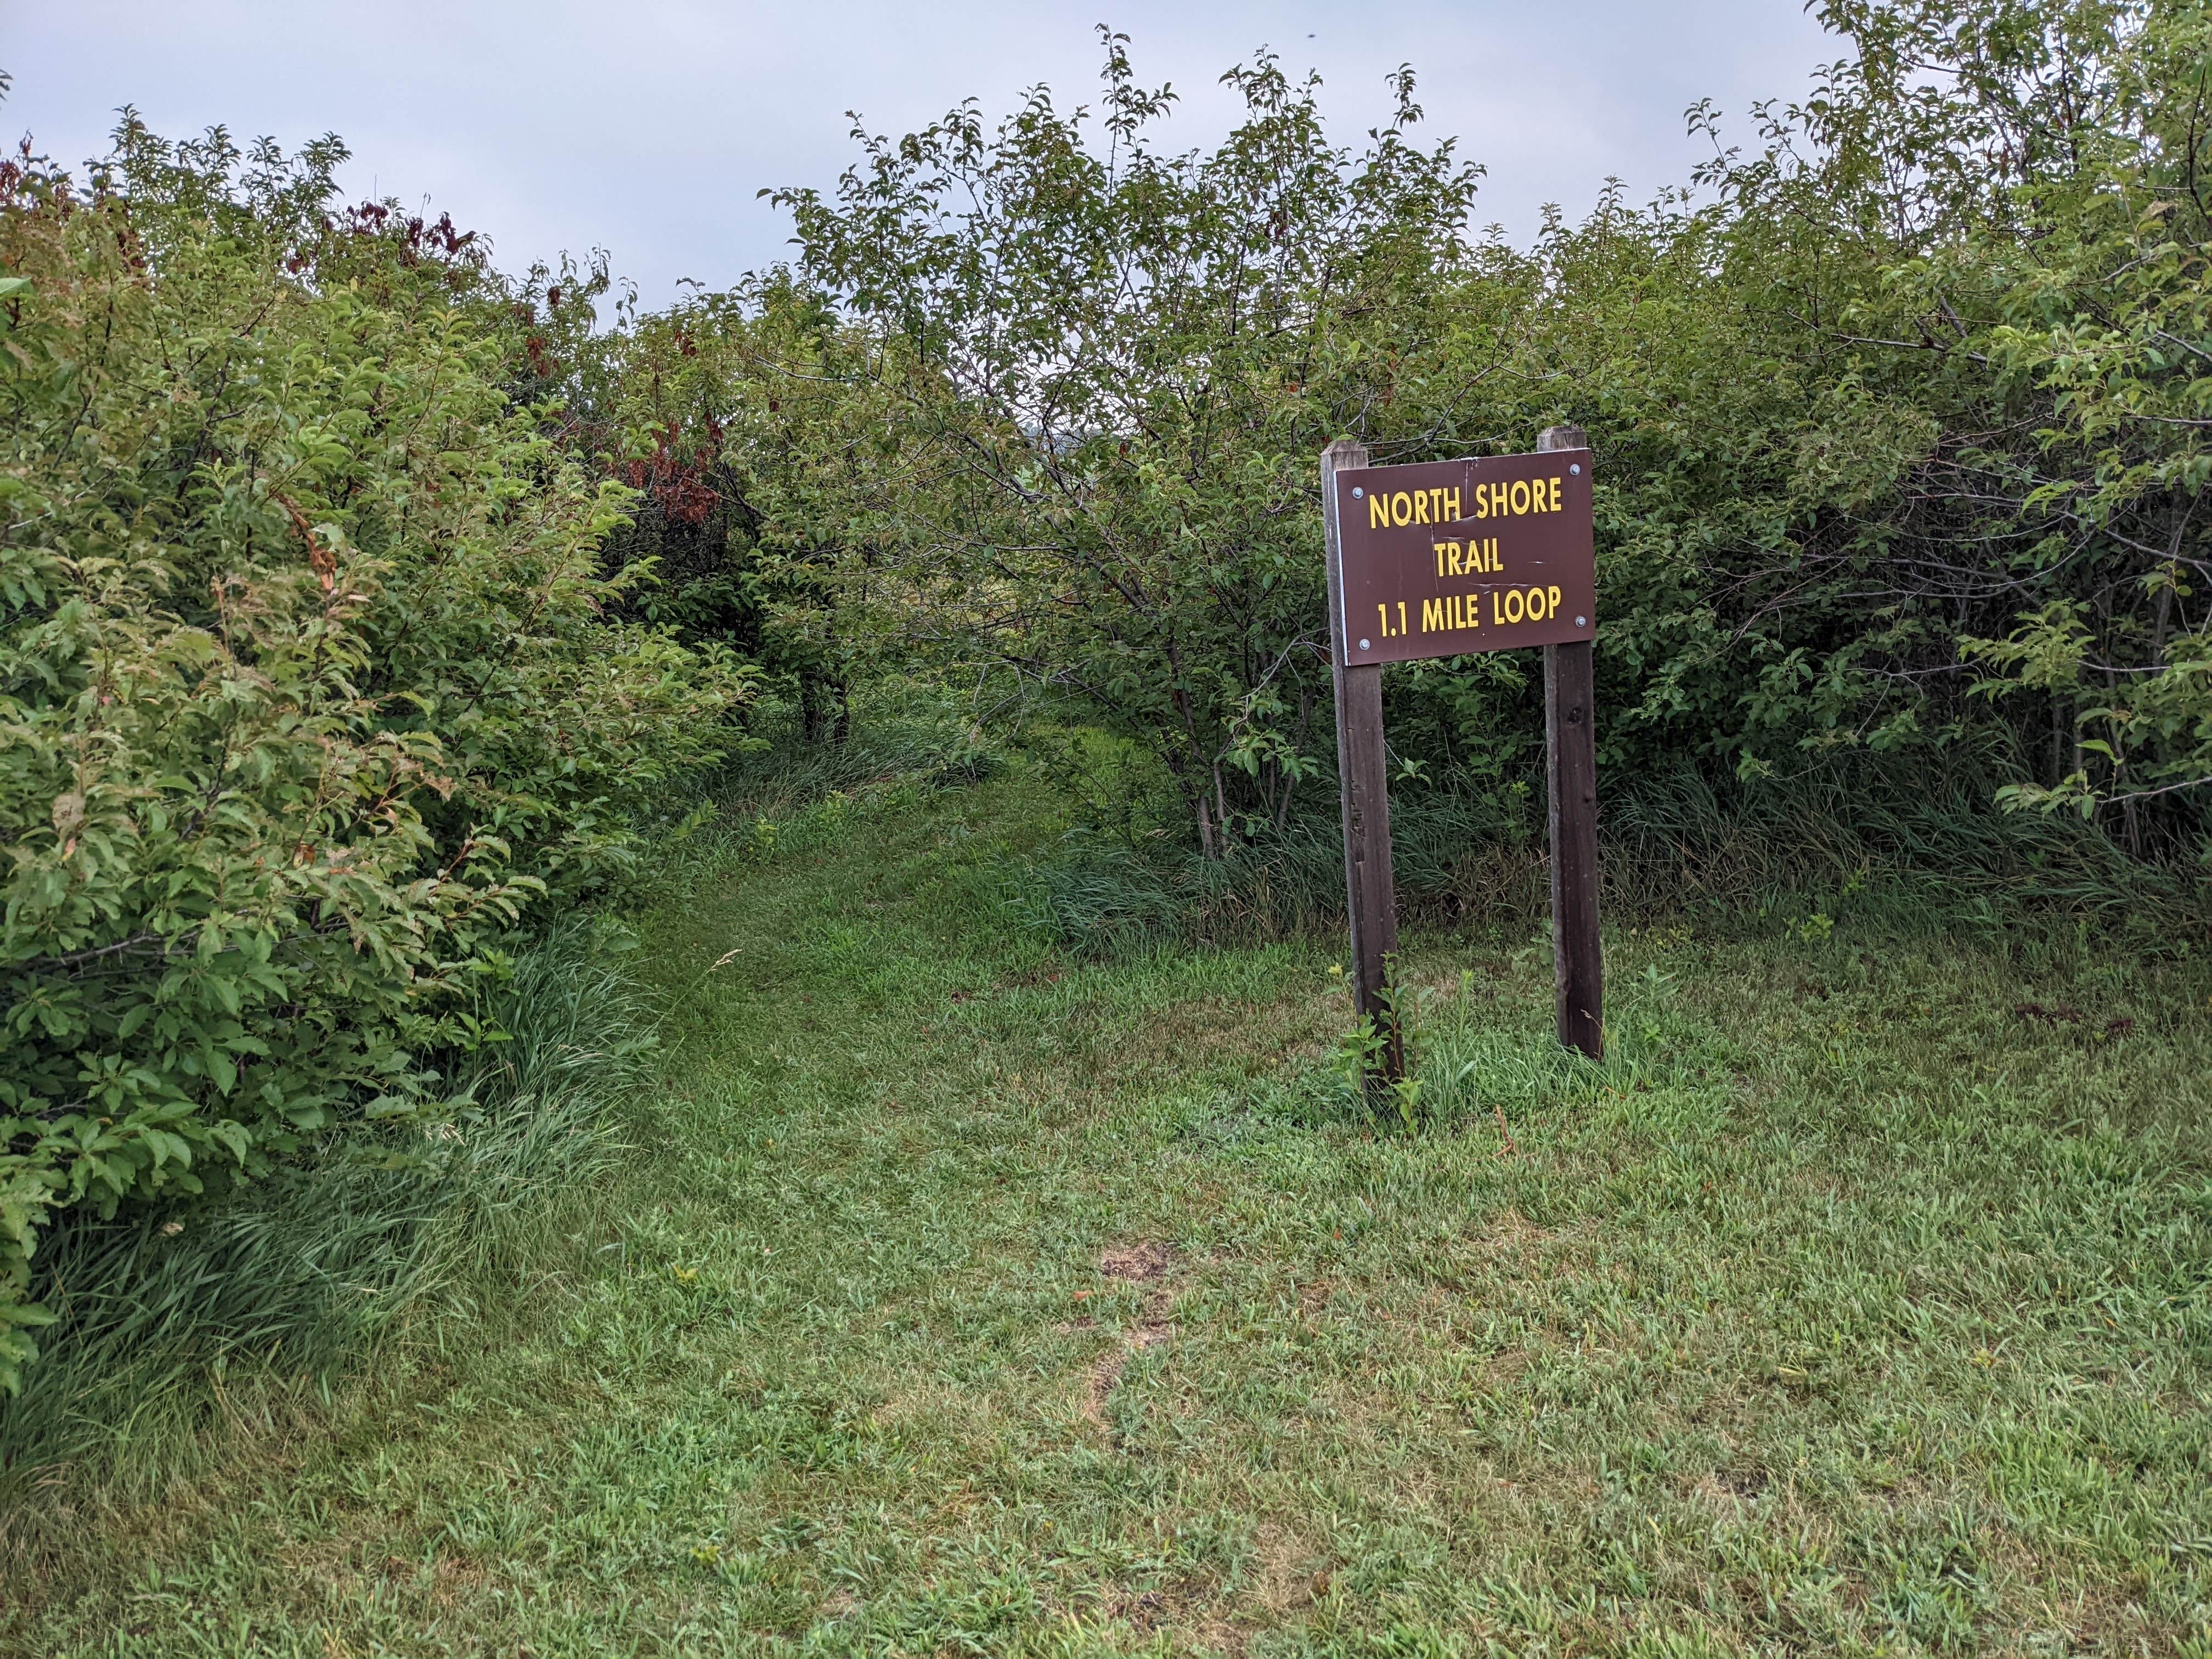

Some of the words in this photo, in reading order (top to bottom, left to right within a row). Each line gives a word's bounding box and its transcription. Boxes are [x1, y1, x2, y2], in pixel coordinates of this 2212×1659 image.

[1369, 486, 1461, 528] NORTH
[1475, 477, 1562, 519] SHORE
[1434, 538, 1504, 577] TRAIL
[1378, 601, 1407, 637] 1.1
[1421, 594, 1480, 633] MILE
[1493, 585, 1562, 625] LOOP
